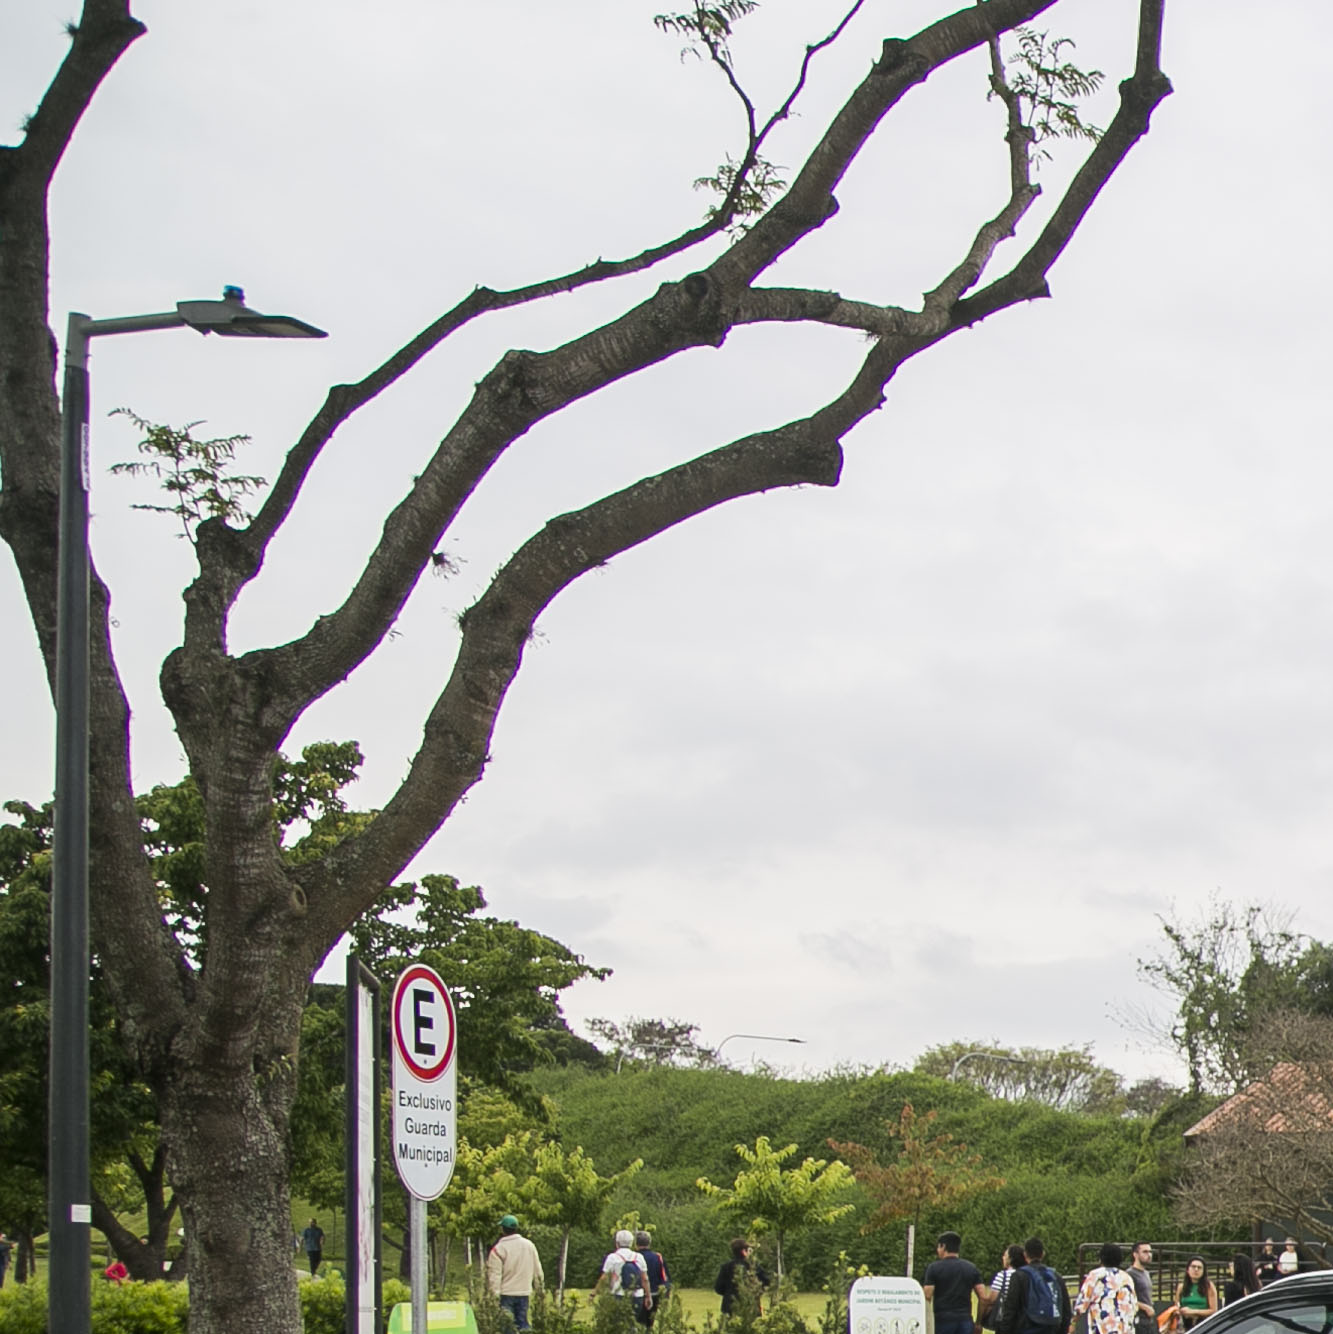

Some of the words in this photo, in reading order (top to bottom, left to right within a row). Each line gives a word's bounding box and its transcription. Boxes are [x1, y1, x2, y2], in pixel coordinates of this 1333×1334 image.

[413, 988, 436, 1056] E
[399, 1090, 452, 1112] Exclusivo
[405, 1118, 447, 1137] Guarda
[399, 1143, 453, 1166] Municipal
